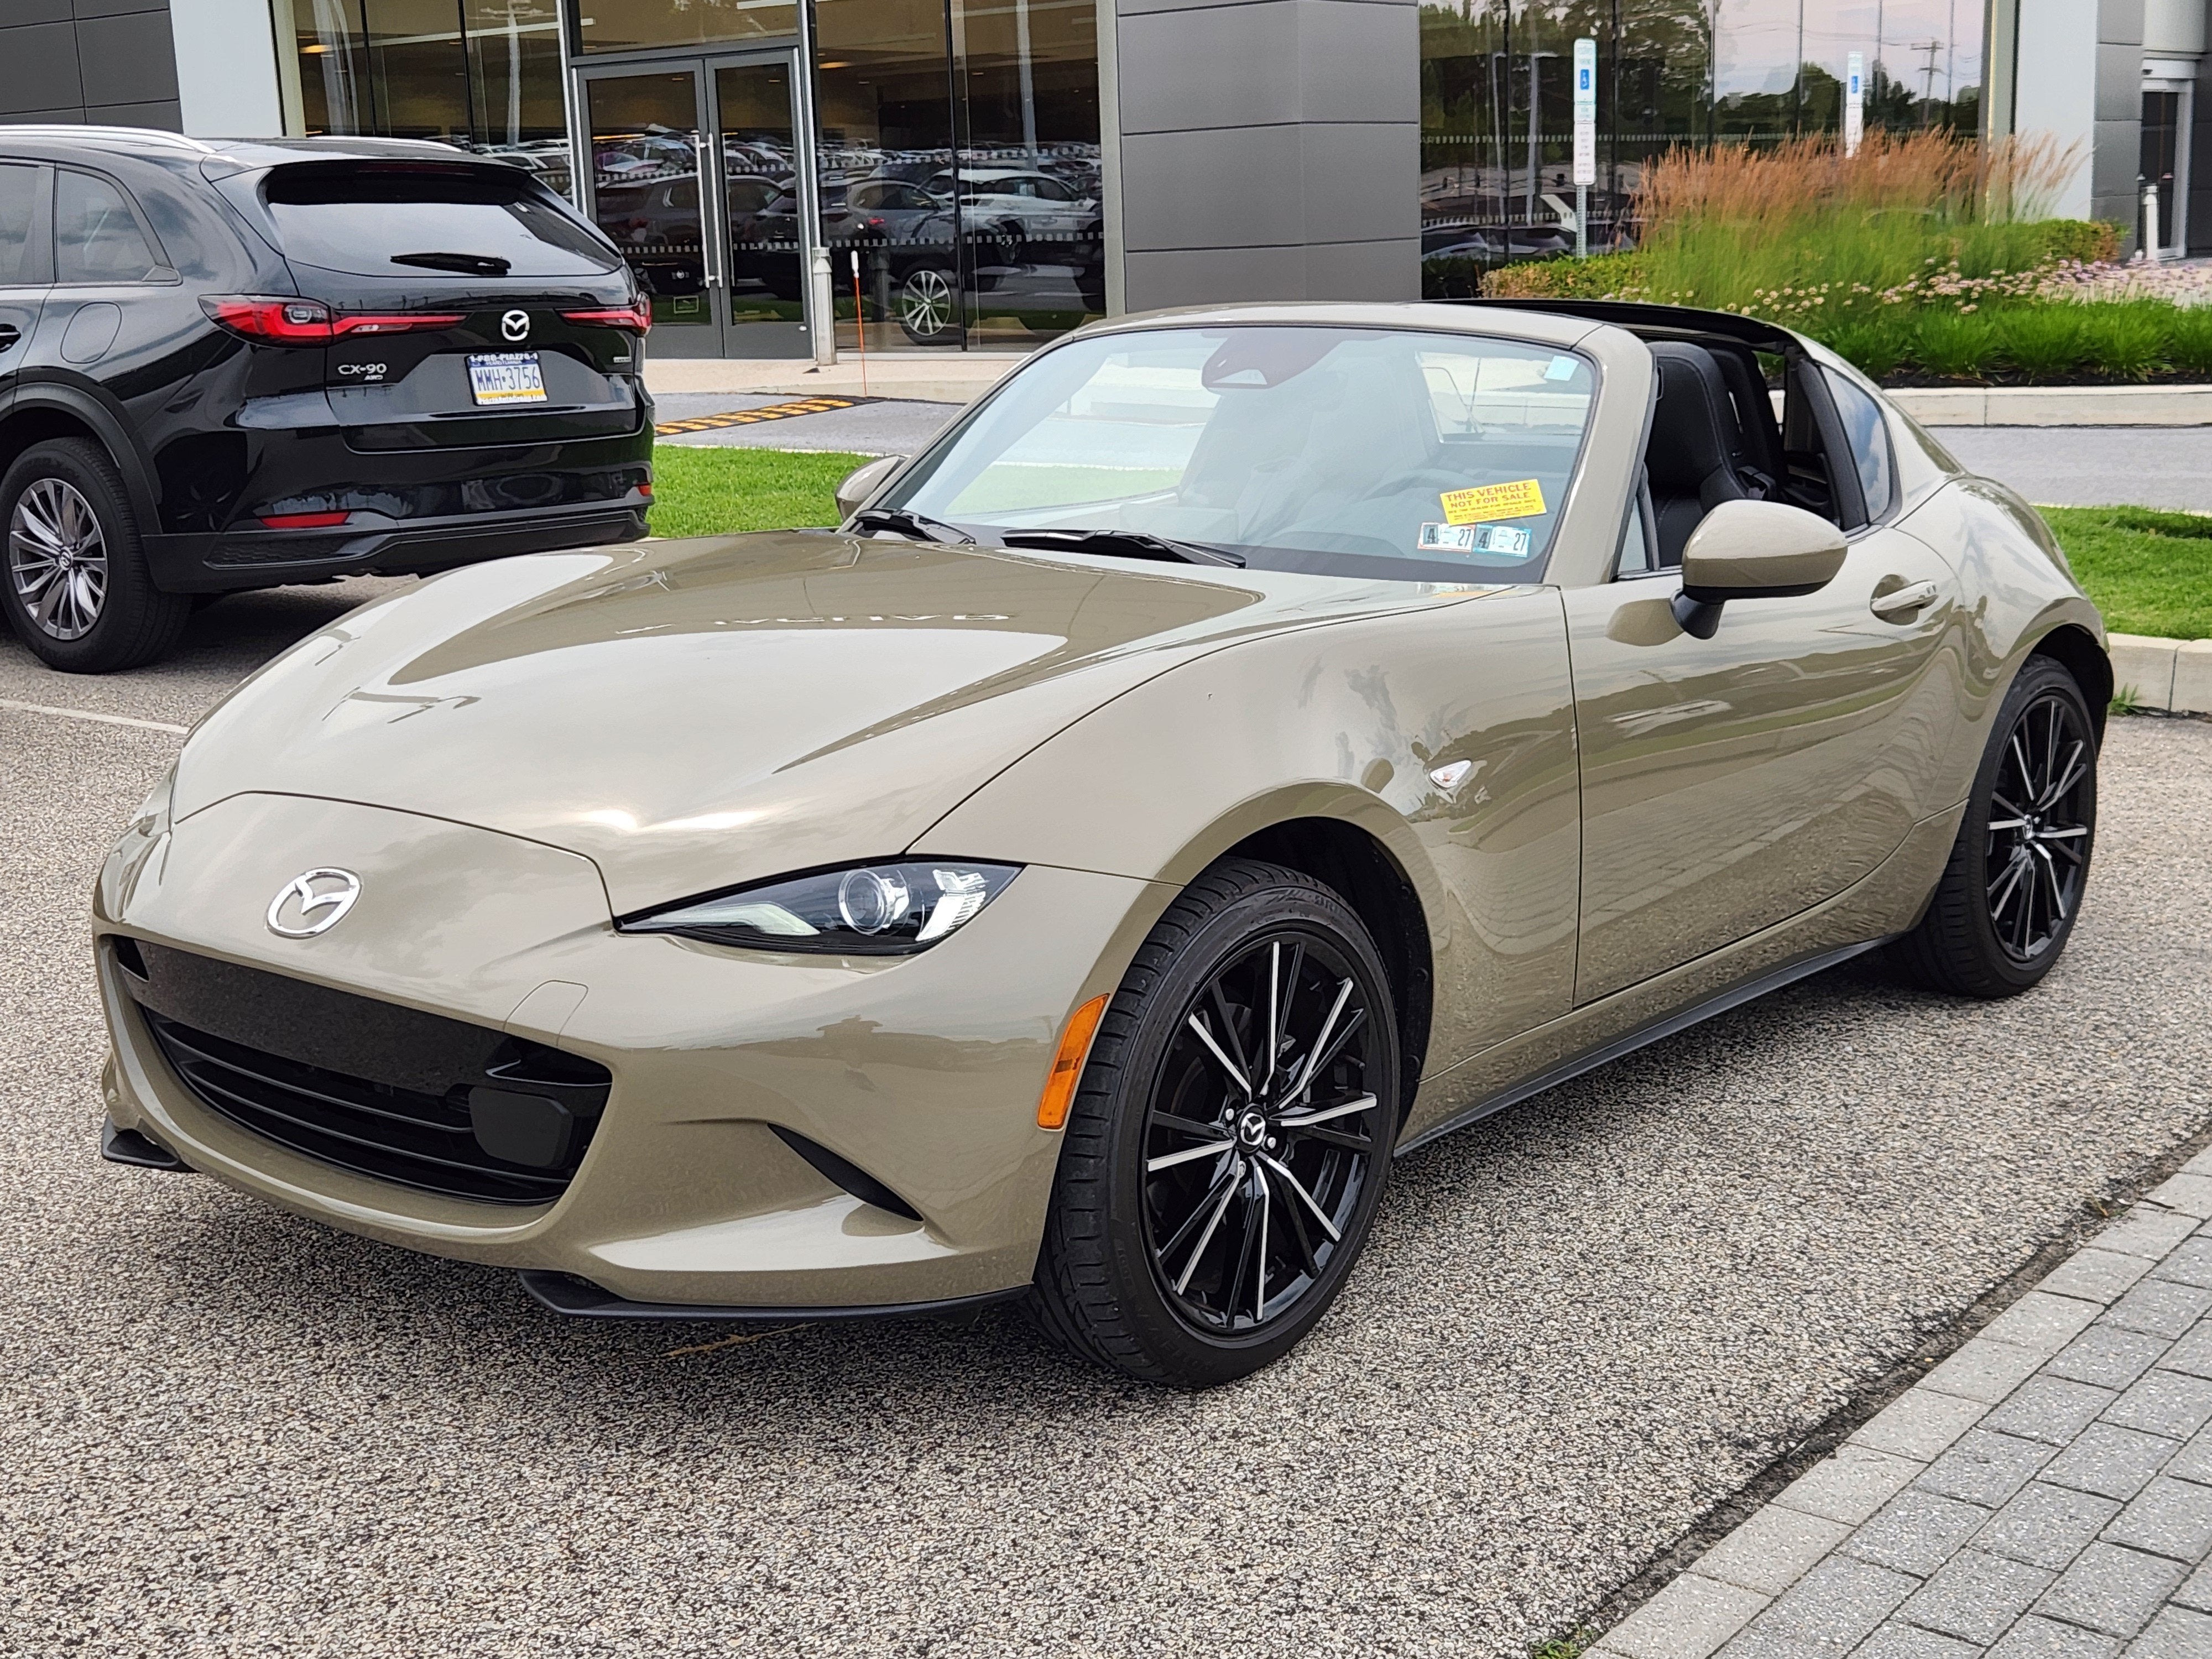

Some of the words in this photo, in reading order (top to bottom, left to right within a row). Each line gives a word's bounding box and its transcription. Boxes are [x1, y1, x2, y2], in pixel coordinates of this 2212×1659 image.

[337, 363, 387, 374] CX-90
[1446, 491, 1475, 502] THIS
[1477, 482, 1532, 497] VEHICLE
[1450, 500, 1473, 509] NOT
[1476, 497, 1498, 505] FOR
[1501, 492, 1530, 501] SALE
[1427, 528, 1436, 544] 4
[1458, 529, 1472, 549] 27
[1478, 531, 1489, 550] 4
[1513, 533, 1527, 552] 27
